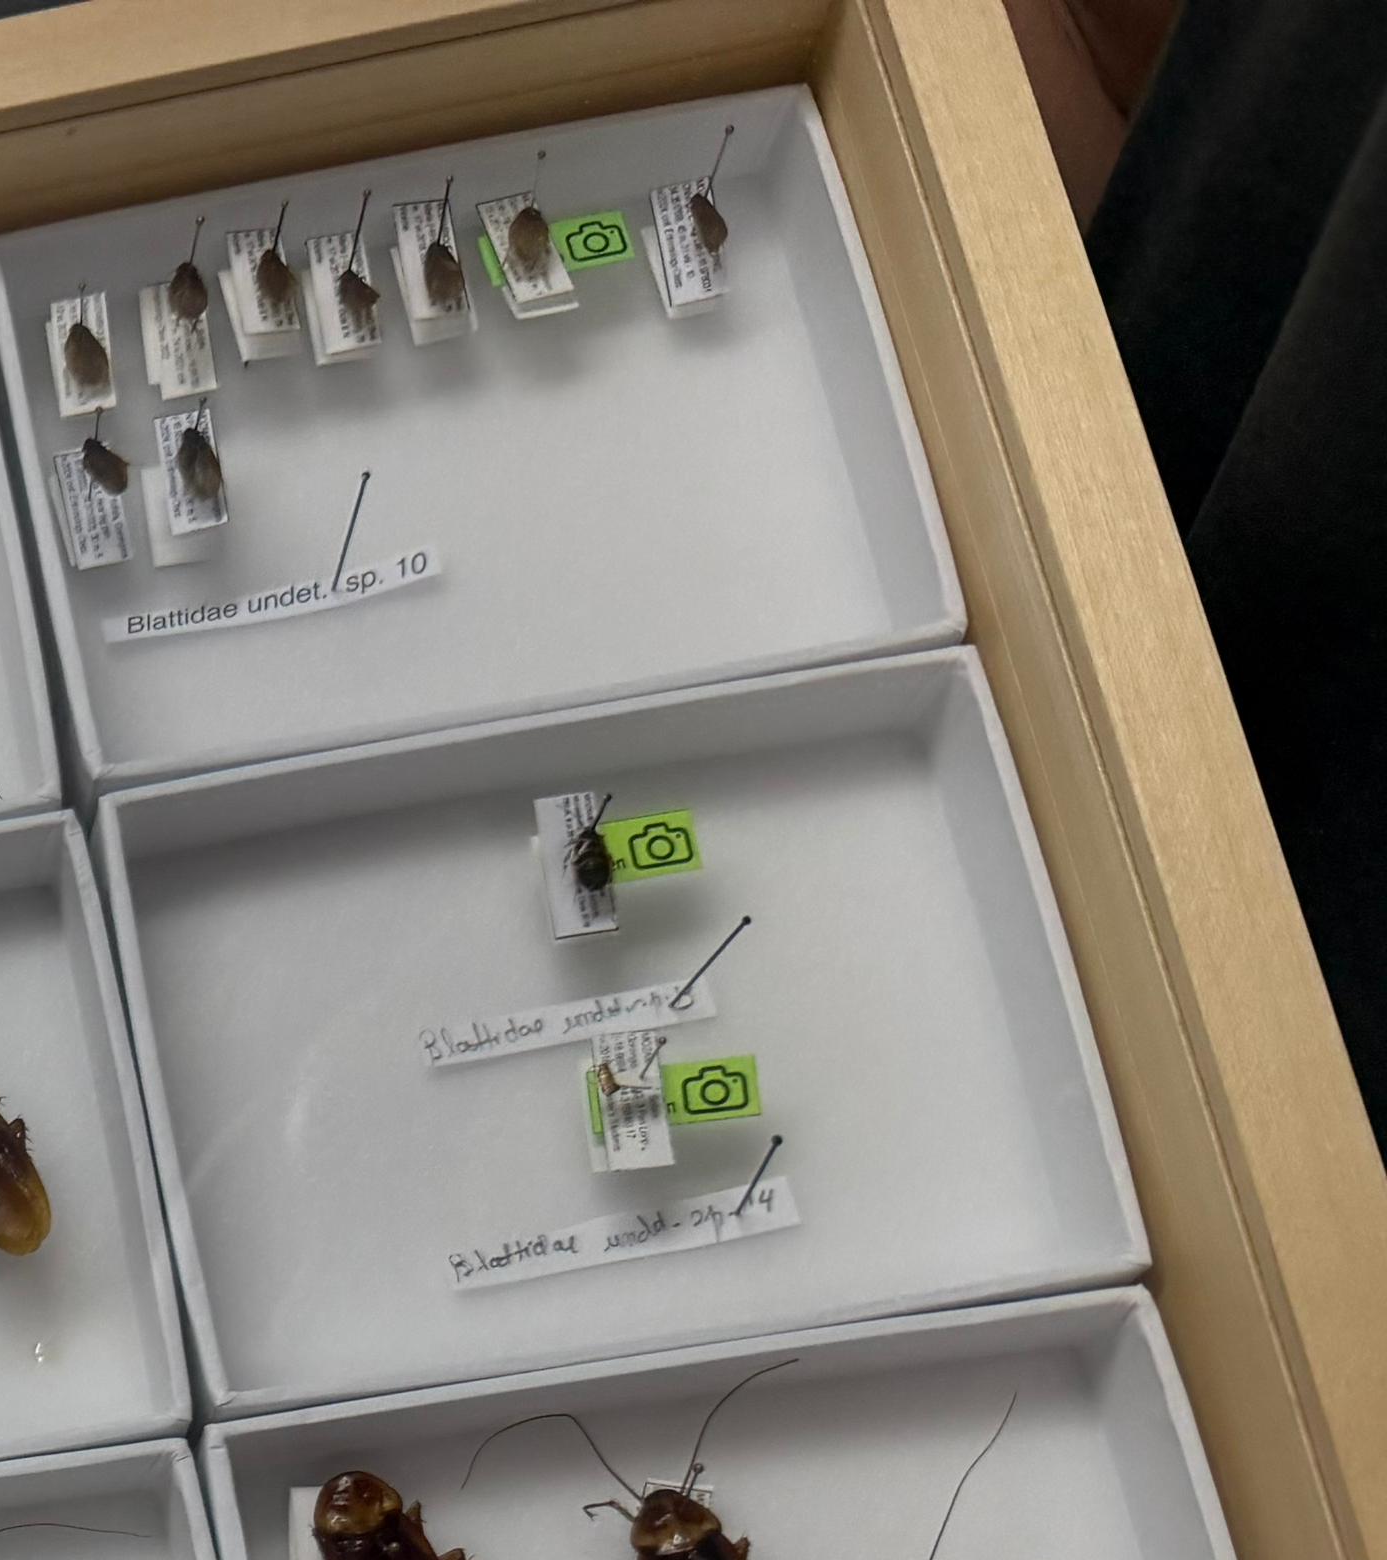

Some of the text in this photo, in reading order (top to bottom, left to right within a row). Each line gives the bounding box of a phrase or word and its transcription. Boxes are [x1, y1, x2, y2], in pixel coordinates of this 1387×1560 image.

[127, 551, 428, 634] Blattidae undet. sp. 10
